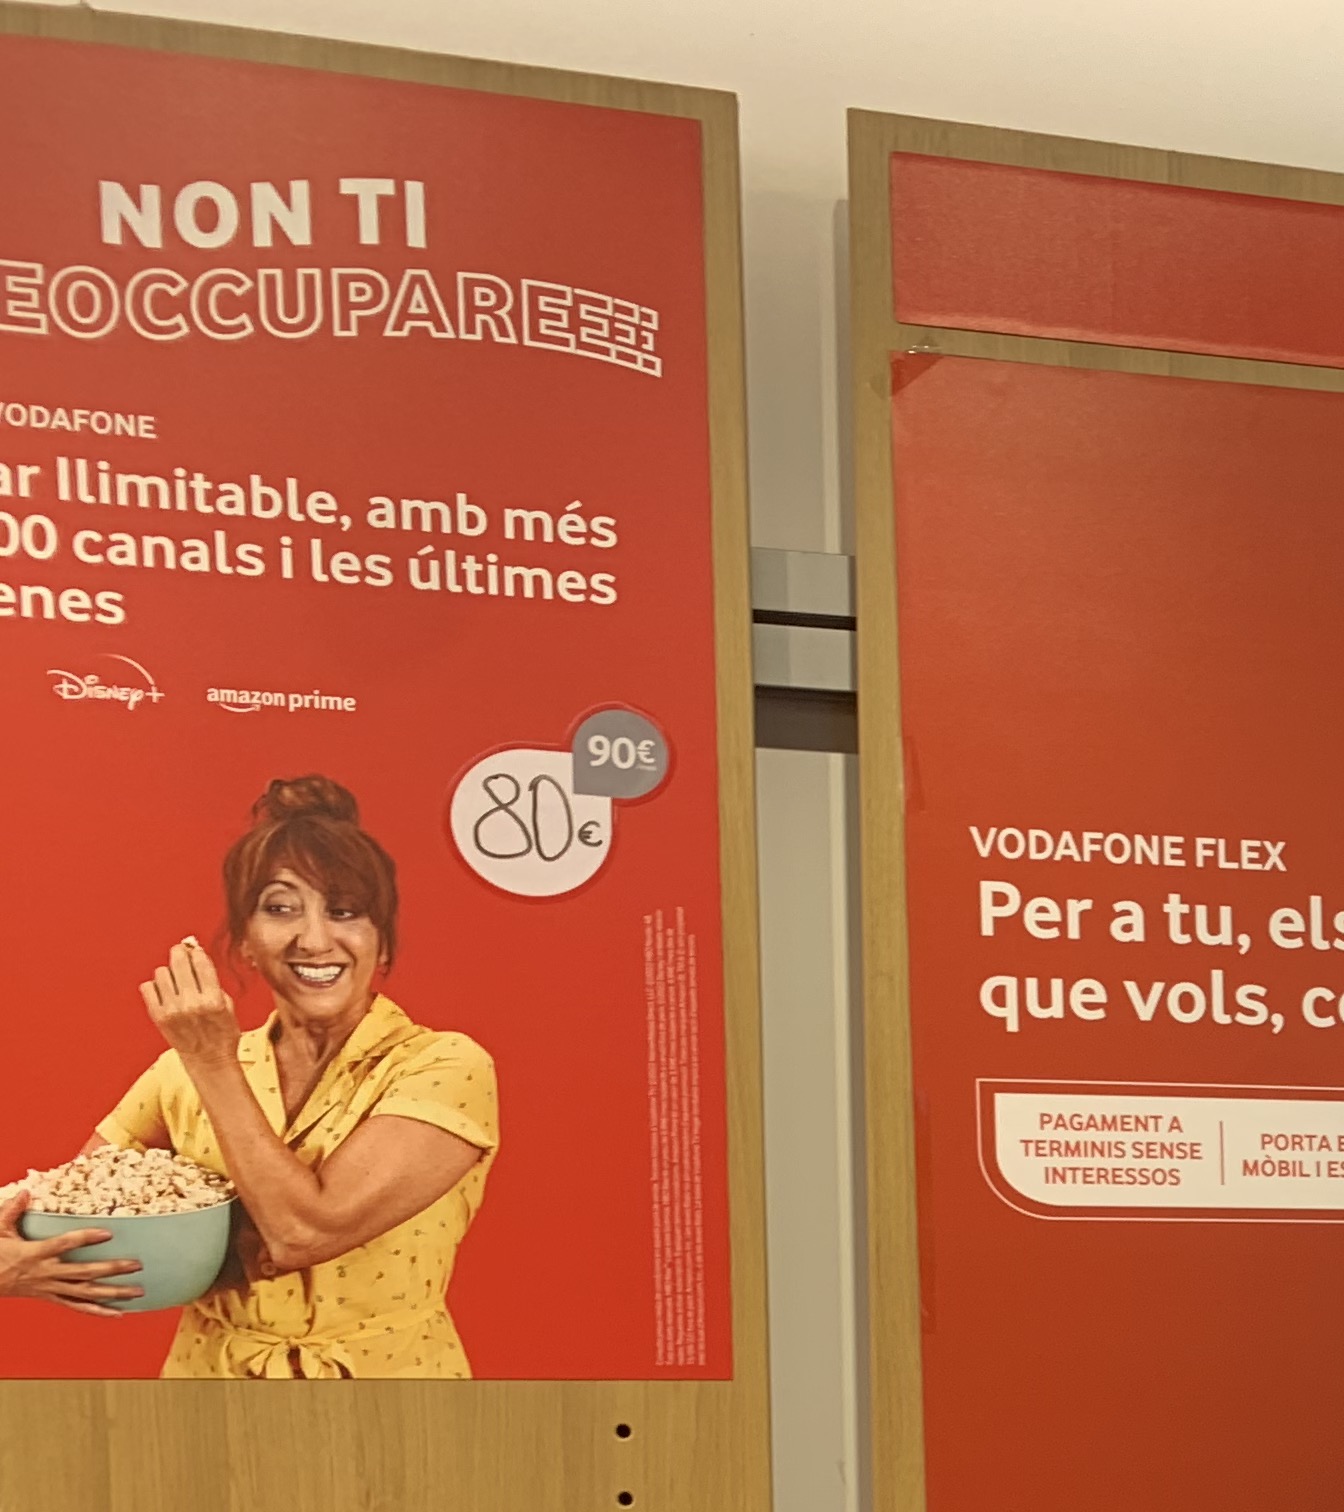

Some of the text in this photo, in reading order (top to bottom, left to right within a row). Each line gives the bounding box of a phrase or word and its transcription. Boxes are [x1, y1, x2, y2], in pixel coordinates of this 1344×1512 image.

[100, 178, 428, 249] NON TI
[0, 403, 158, 440] ODAFONE
[366, 493, 488, 538] amb
[503, 501, 619, 549] més
[72, 529, 265, 578] canals
[281, 538, 295, 579] i
[311, 539, 393, 589] les
[408, 546, 619, 606] últimes
[206, 687, 357, 713] amazon prime
[587, 734, 657, 769] 90€
[473, 773, 603, 863] 80€
[970, 826, 1288, 872] VODAFONE FLEX
[978, 880, 1094, 941] Per
[1109, 901, 1146, 944] a
[1163, 893, 1253, 954] tu,
[978, 974, 1109, 1033] que
[1123, 970, 1286, 1035] vols,
[1038, 1111, 1185, 1135] PAGAMENT A
[1019, 1138, 1204, 1162] TERMINIS SENSE
[1259, 1132, 1333, 1153] PORTA
[1043, 1165, 1182, 1187] INTERESSOS
[1241, 1153, 1312, 1179] MÒBIL
[1315, 1161, 1322, 1179] I
